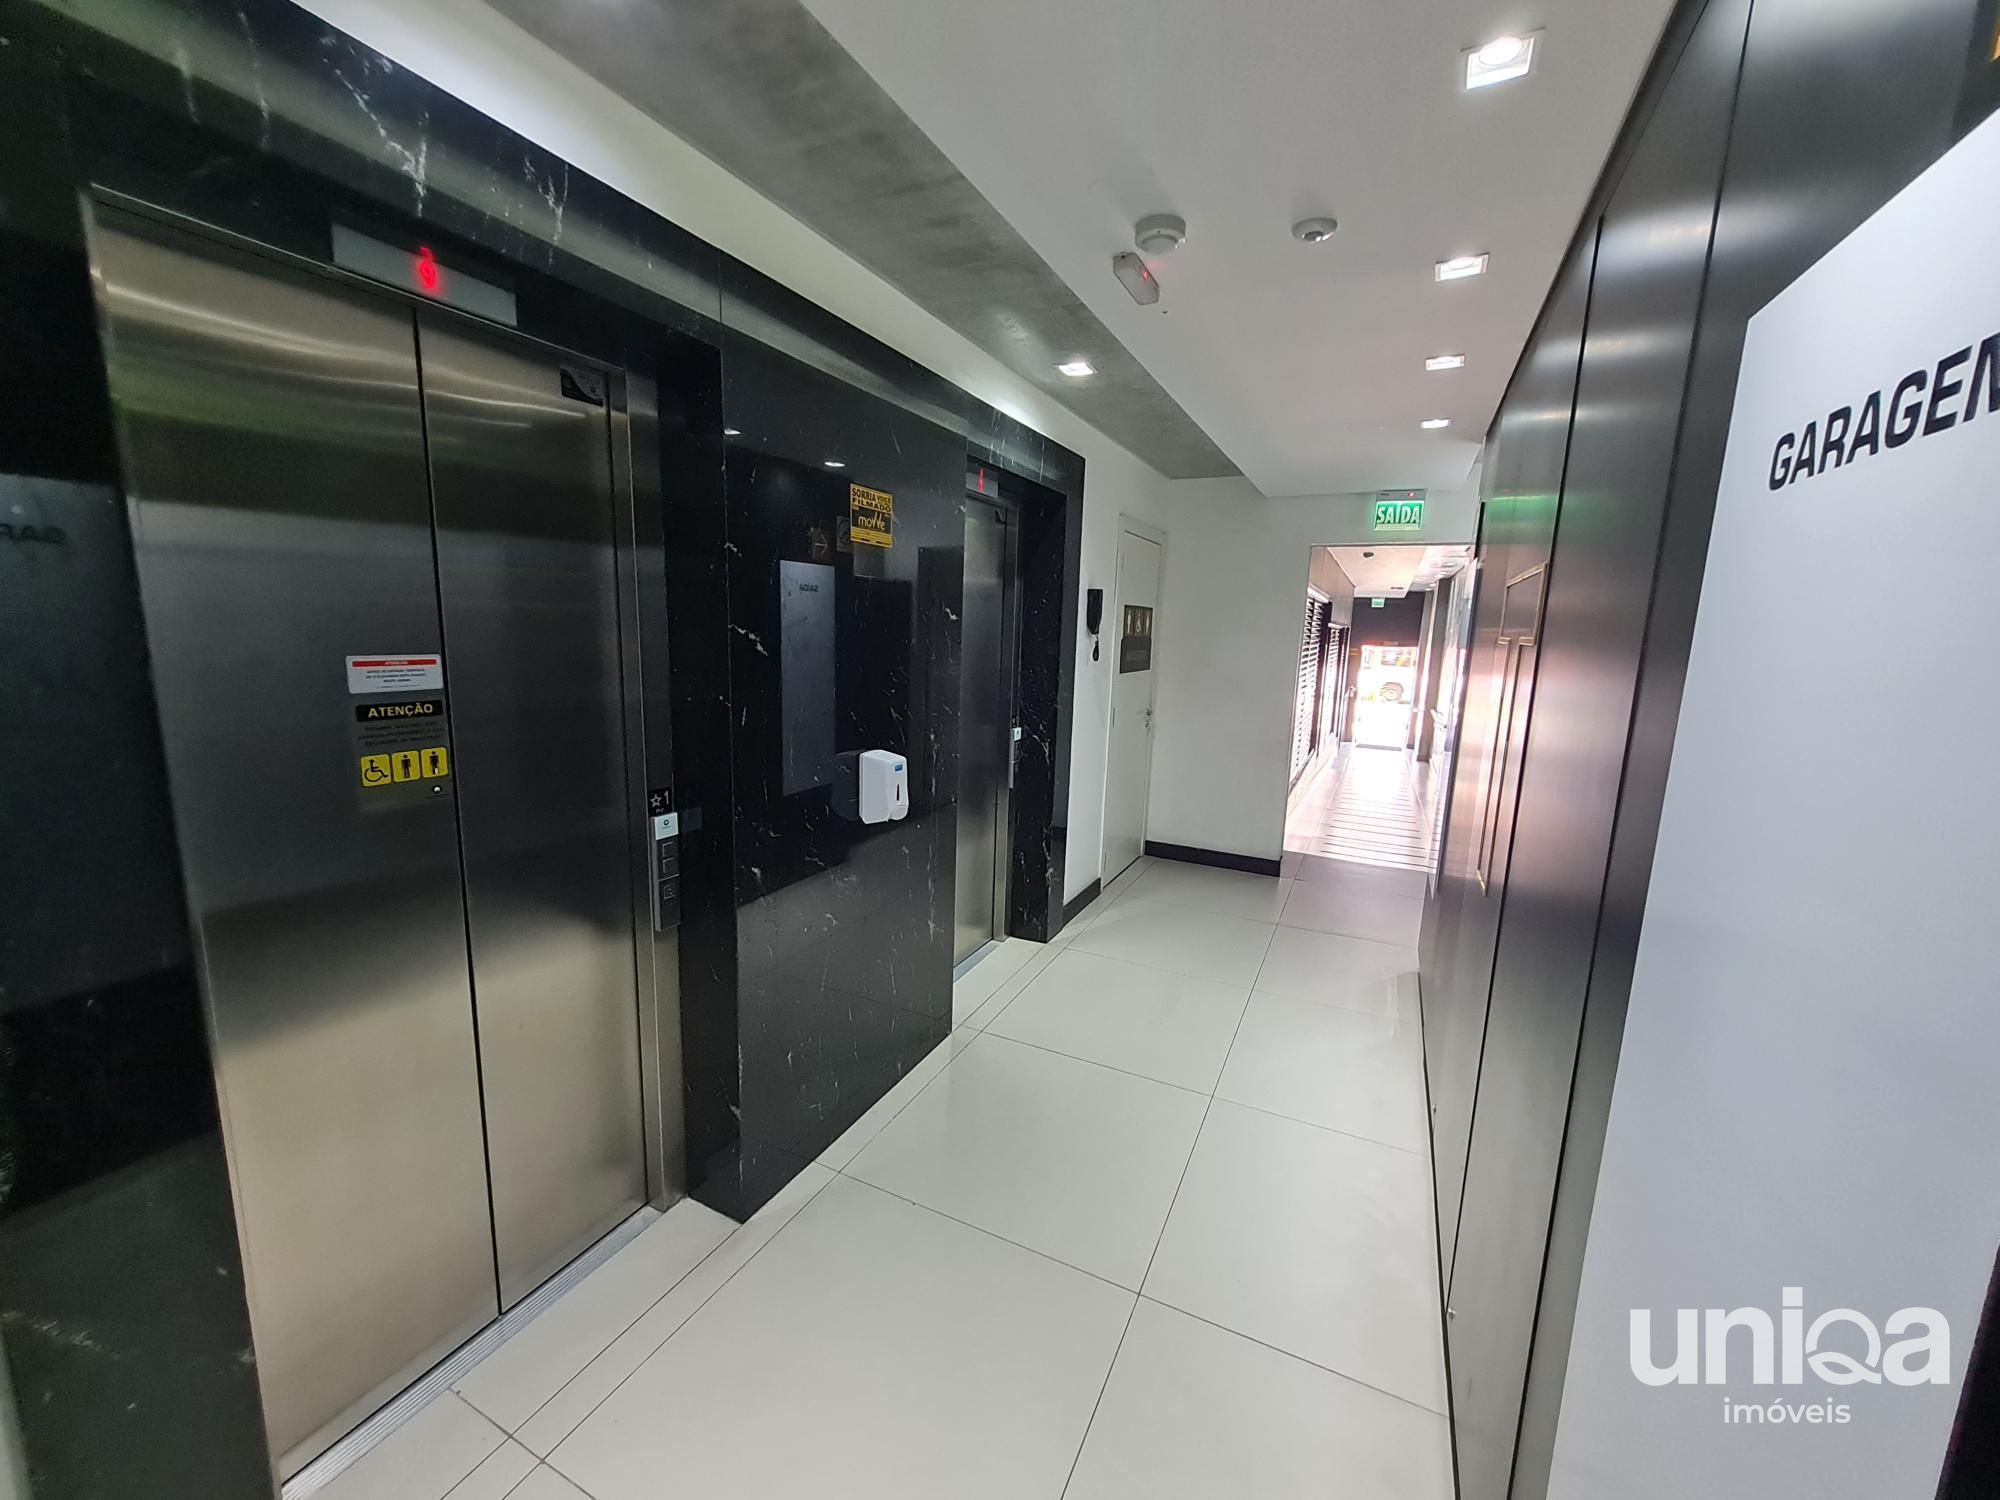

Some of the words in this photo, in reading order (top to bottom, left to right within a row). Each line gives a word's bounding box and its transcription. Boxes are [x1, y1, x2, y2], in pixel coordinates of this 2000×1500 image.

[852, 487, 876, 501] SORRIA
[852, 497, 891, 512] FILMADO
[367, 703, 434, 718] ATENÇÃO
